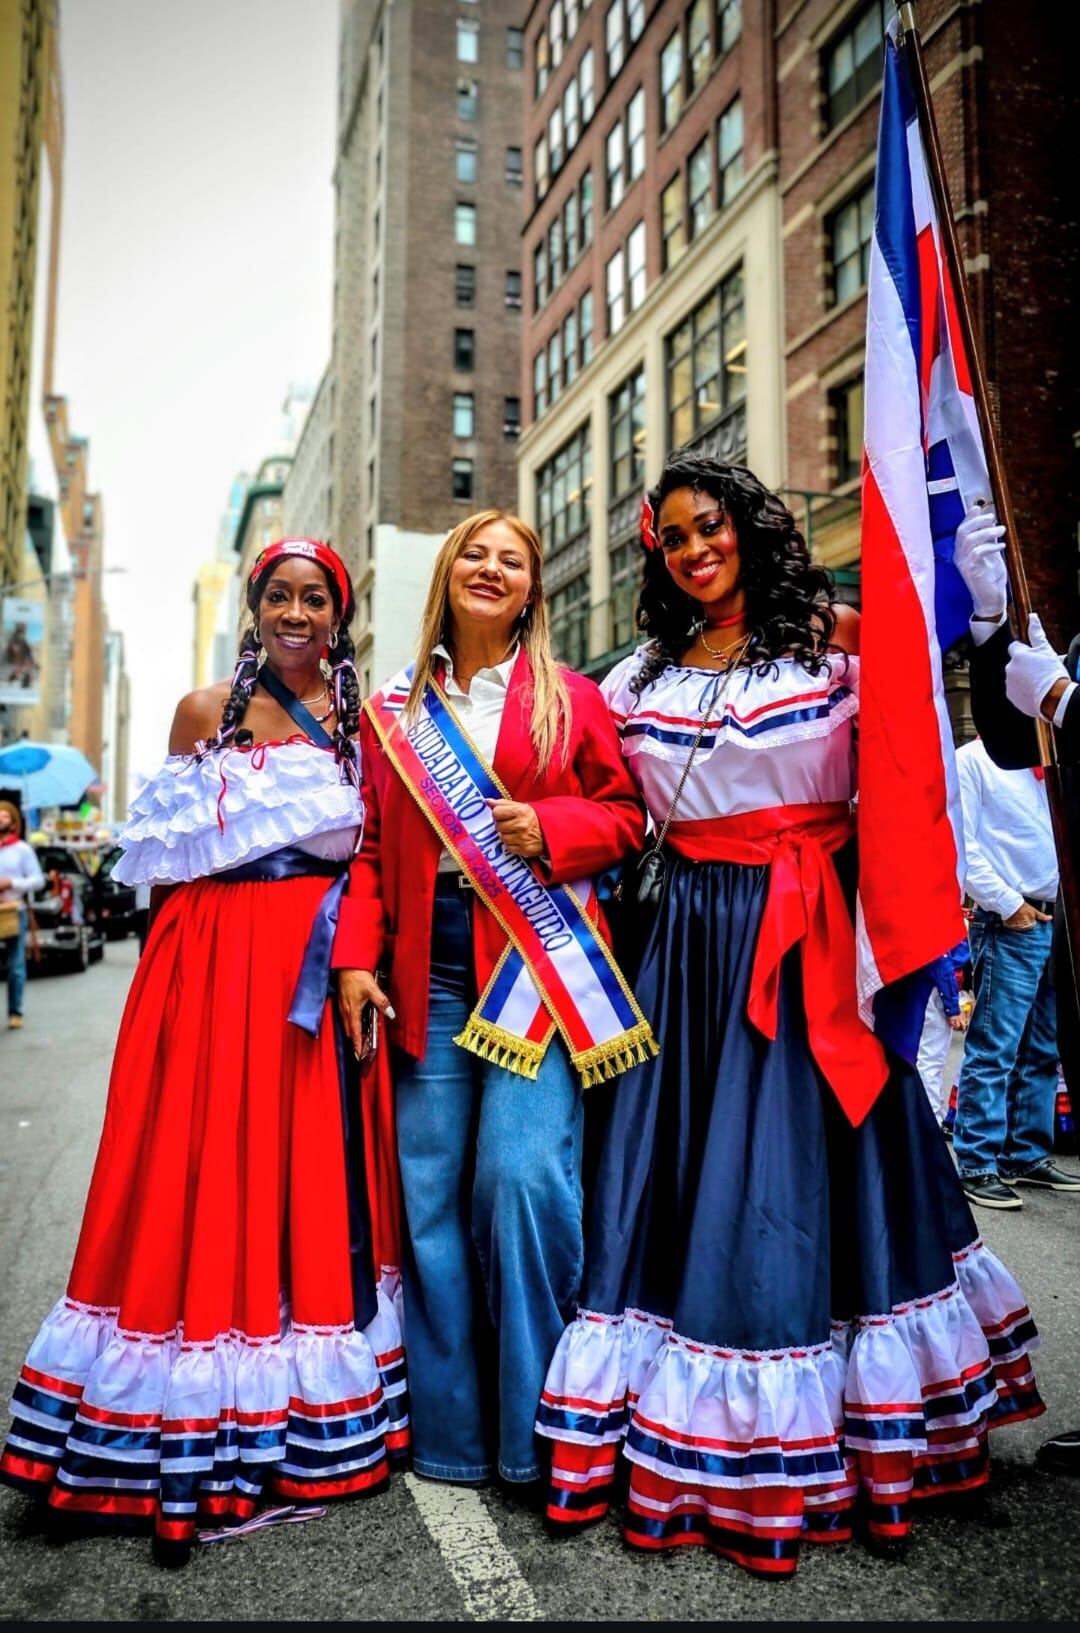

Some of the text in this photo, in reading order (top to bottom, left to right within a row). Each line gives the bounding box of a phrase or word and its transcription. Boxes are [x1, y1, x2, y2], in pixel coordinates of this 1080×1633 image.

[407, 717, 573, 952] CIUDADANO DISTINGUIDO
[421, 776, 463, 836] SECTOR
